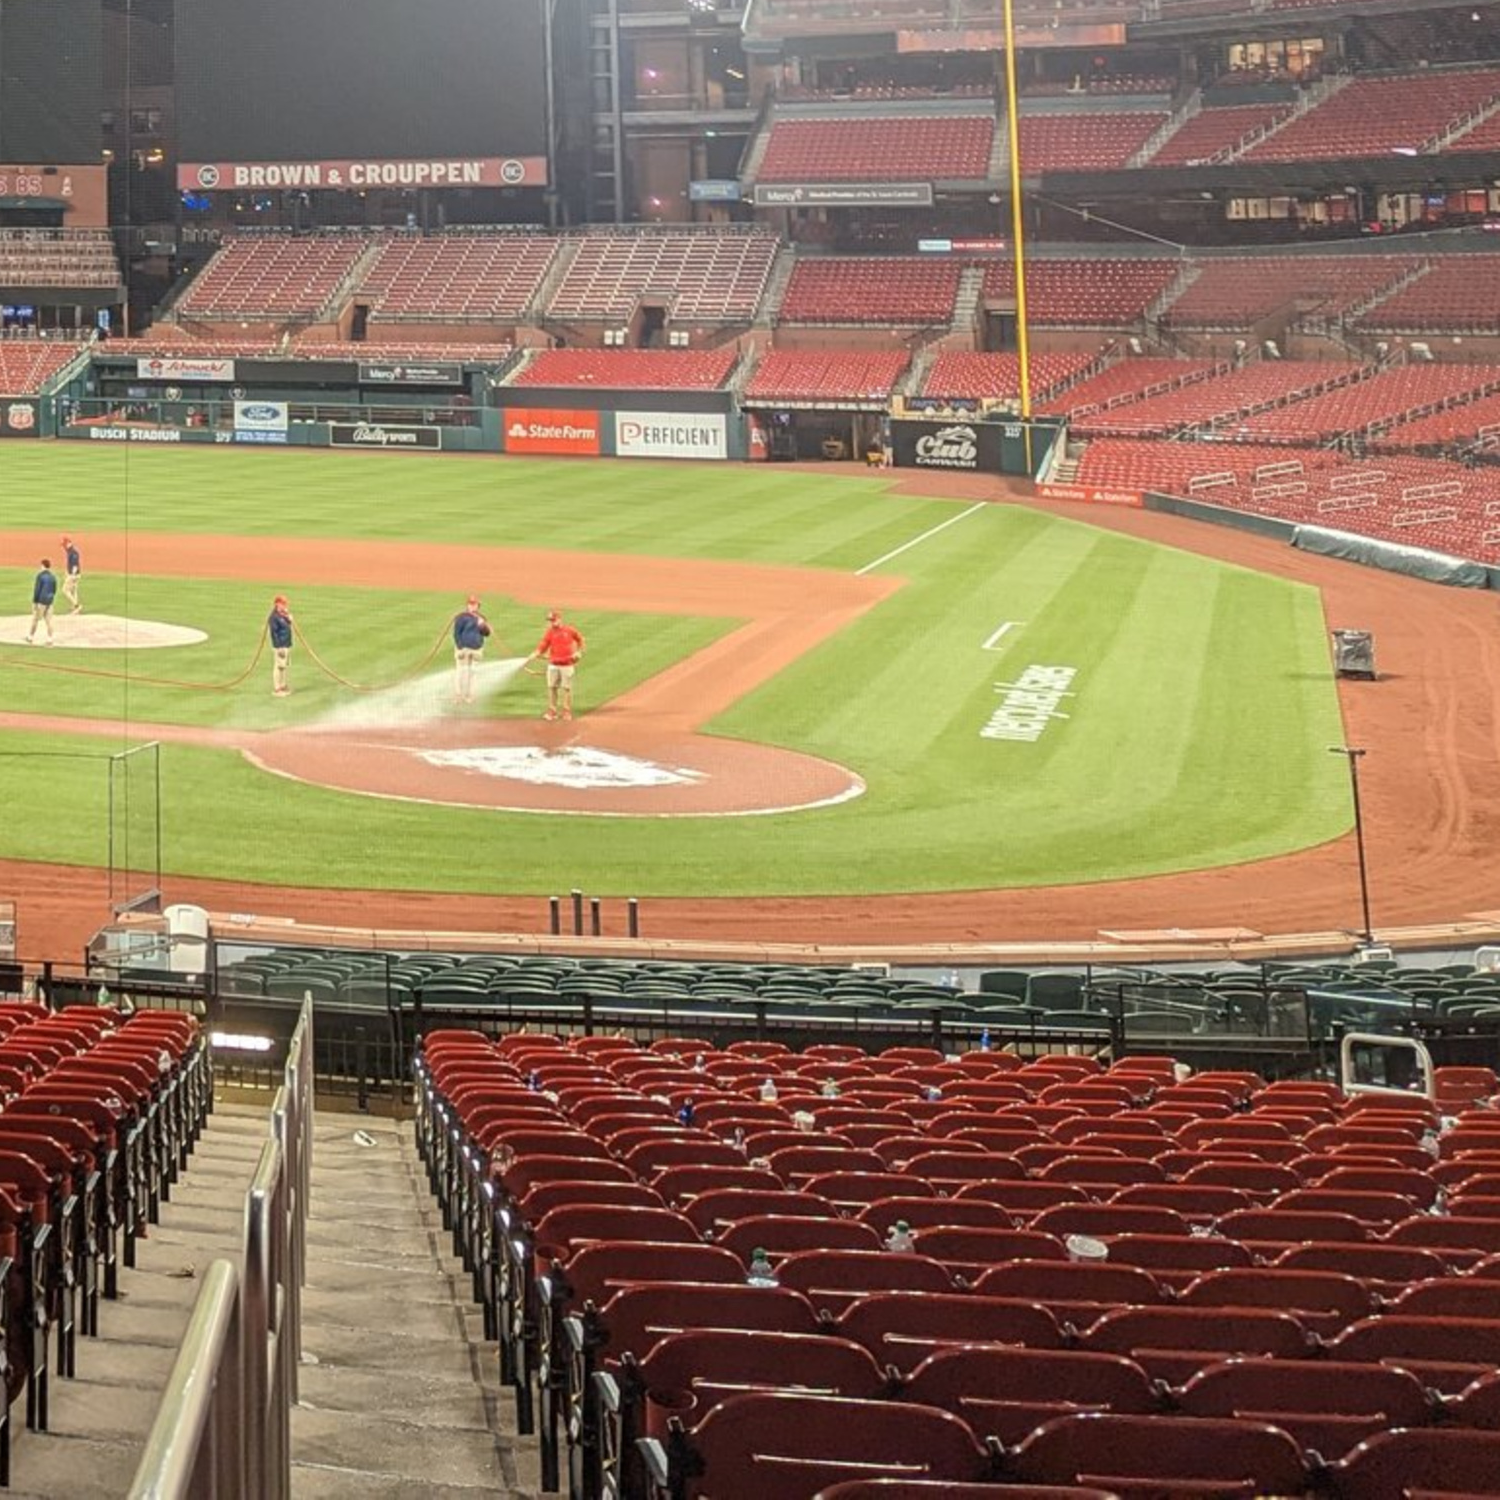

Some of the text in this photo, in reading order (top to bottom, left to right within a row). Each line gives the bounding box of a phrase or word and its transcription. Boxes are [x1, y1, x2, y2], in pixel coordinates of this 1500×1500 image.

[235, 164, 320, 186] BROWN
[327, 170, 341, 184] &
[350, 163, 480, 183] CROUPPEN
[90, 427, 181, 441] BUSCH STADIUM
[621, 422, 719, 445] PERFICIENT
[916, 435, 977, 459] Club
